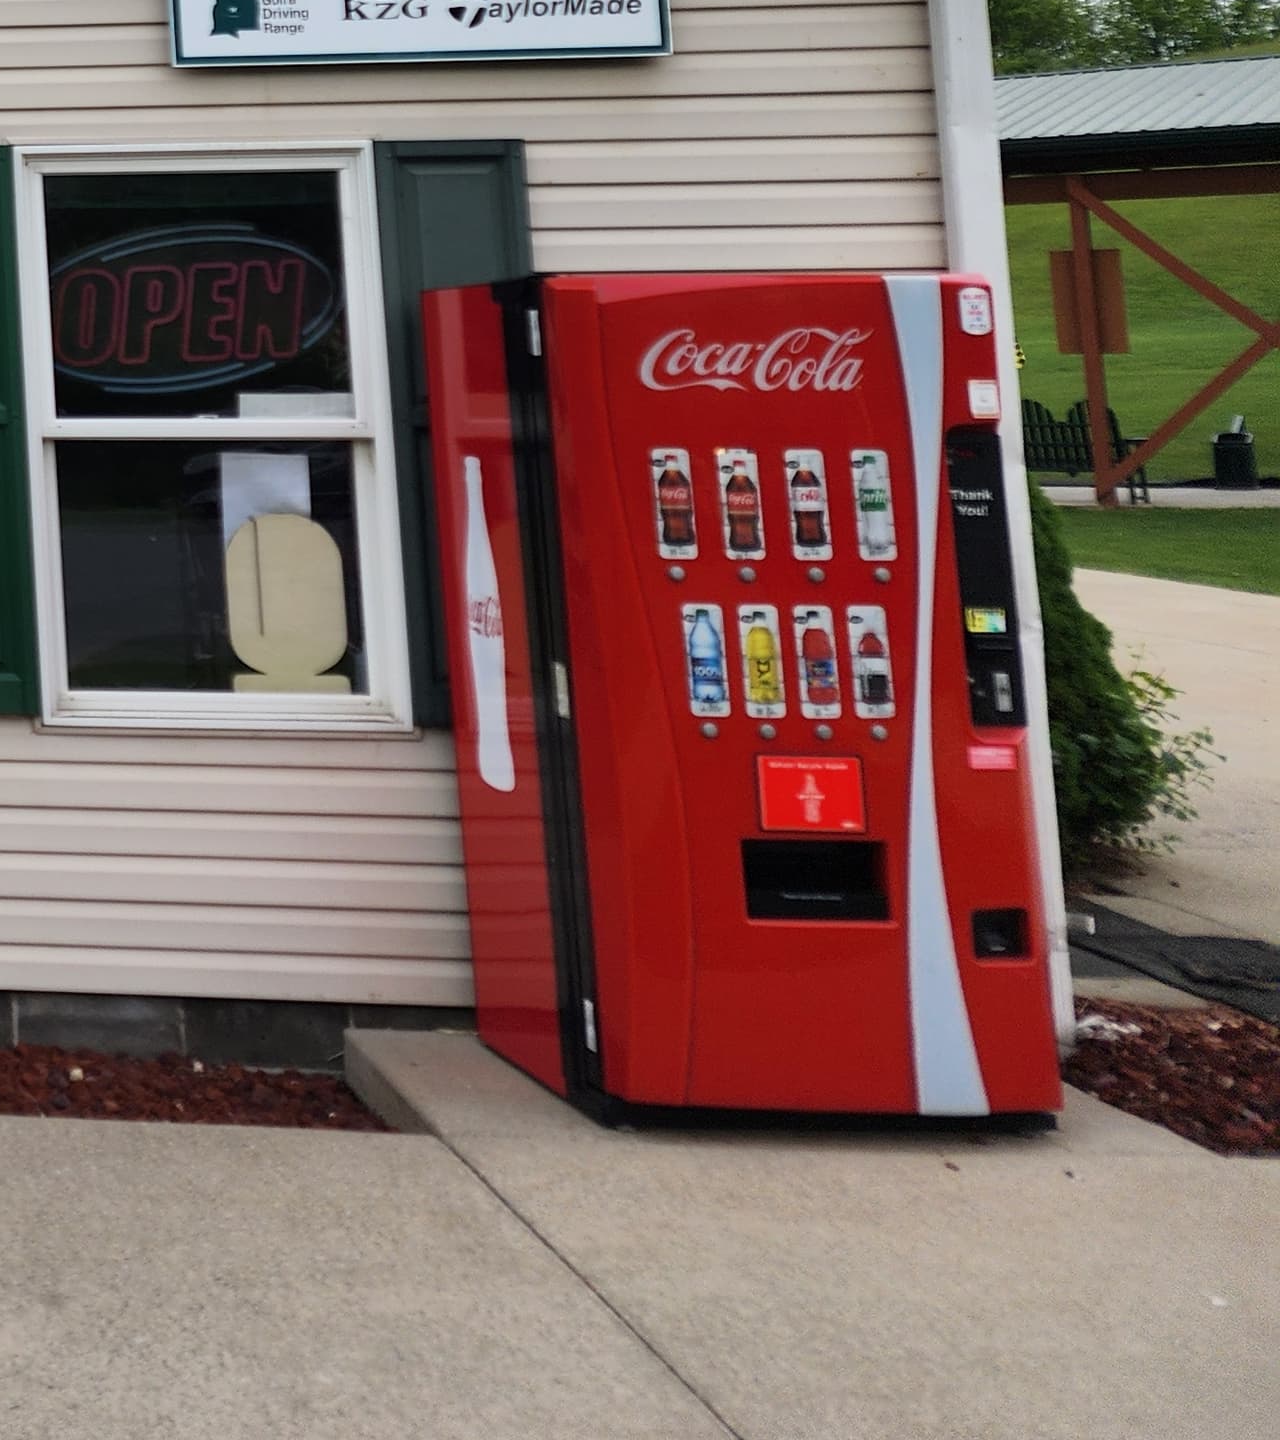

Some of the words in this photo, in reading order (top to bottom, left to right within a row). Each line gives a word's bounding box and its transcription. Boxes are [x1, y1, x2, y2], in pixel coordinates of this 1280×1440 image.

[263, 7, 309, 21] Driving
[264, 22, 305, 36] Range
[53, 258, 306, 368] OPEN
[638, 327, 875, 393] Coca-Cola
[949, 489, 995, 501] Thank
